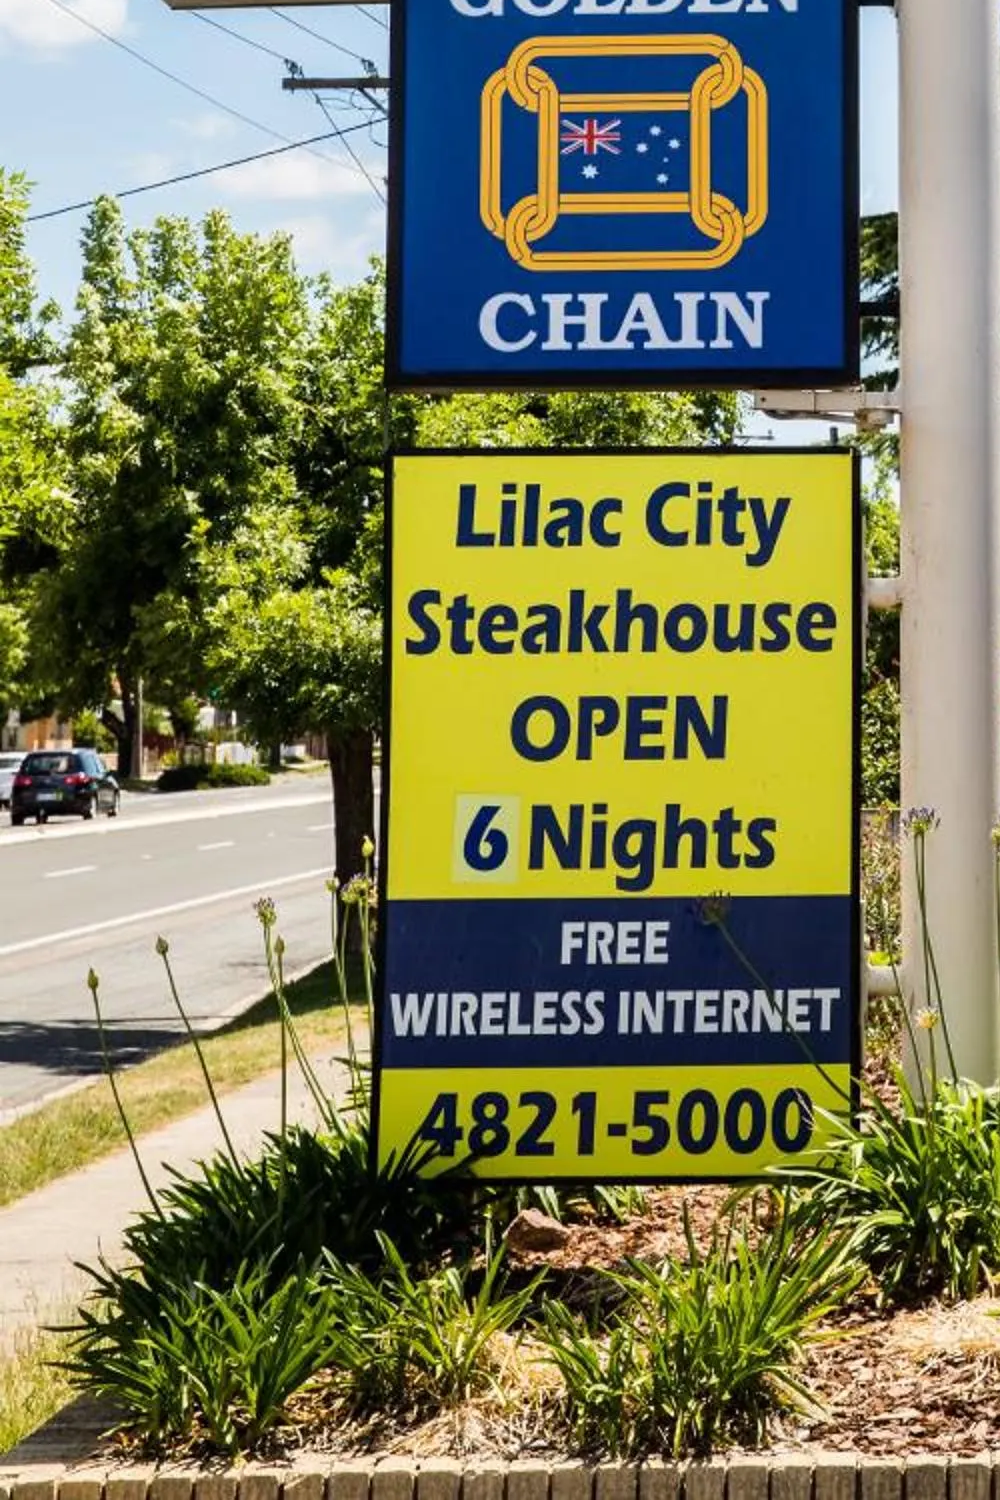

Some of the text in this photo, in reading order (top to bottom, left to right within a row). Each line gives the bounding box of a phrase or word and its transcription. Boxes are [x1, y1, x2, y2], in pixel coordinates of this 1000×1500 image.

[478, 291, 770, 353] CHAIN
[456, 481, 791, 567] Lilac City
[405, 588, 837, 655] Steakhouse
[510, 695, 729, 763] OPEN
[463, 803, 778, 892] 6 Nights
[561, 921, 669, 965] FREE
[391, 987, 840, 1037] WIRELESS INTERNET
[421, 1087, 814, 1157] 4821-5000
